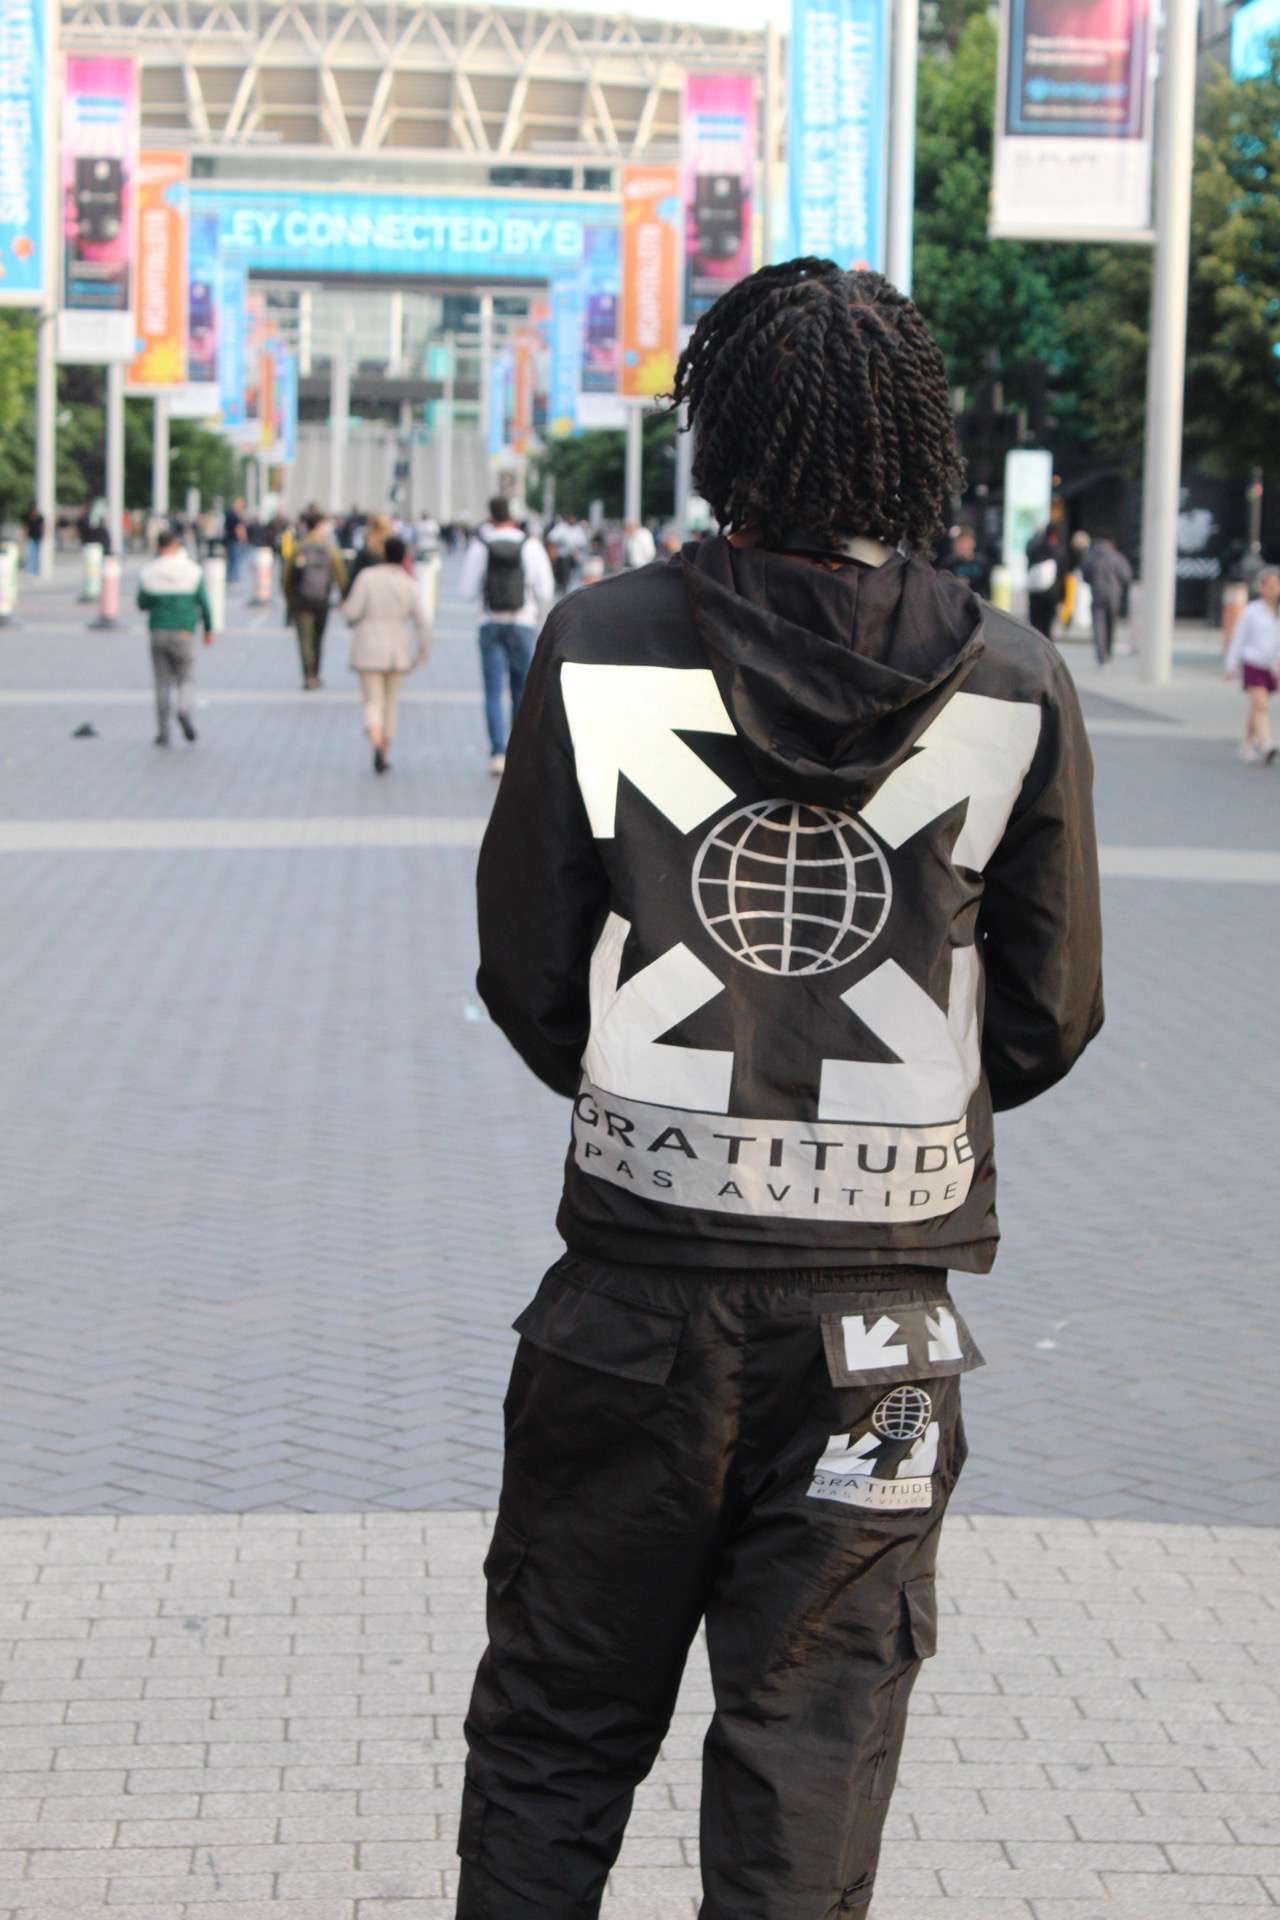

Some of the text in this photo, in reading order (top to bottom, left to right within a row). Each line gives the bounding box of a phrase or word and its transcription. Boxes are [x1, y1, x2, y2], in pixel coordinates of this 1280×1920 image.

[284, 212, 497, 251] CONNECTED
[503, 219, 550, 255] BY
[802, 206, 833, 254] THE
[574, 1092, 975, 1175] GRATITUDE
[584, 1142, 958, 1208] PAS AVITIDE
[814, 1474, 932, 1495] GRATITUDE
